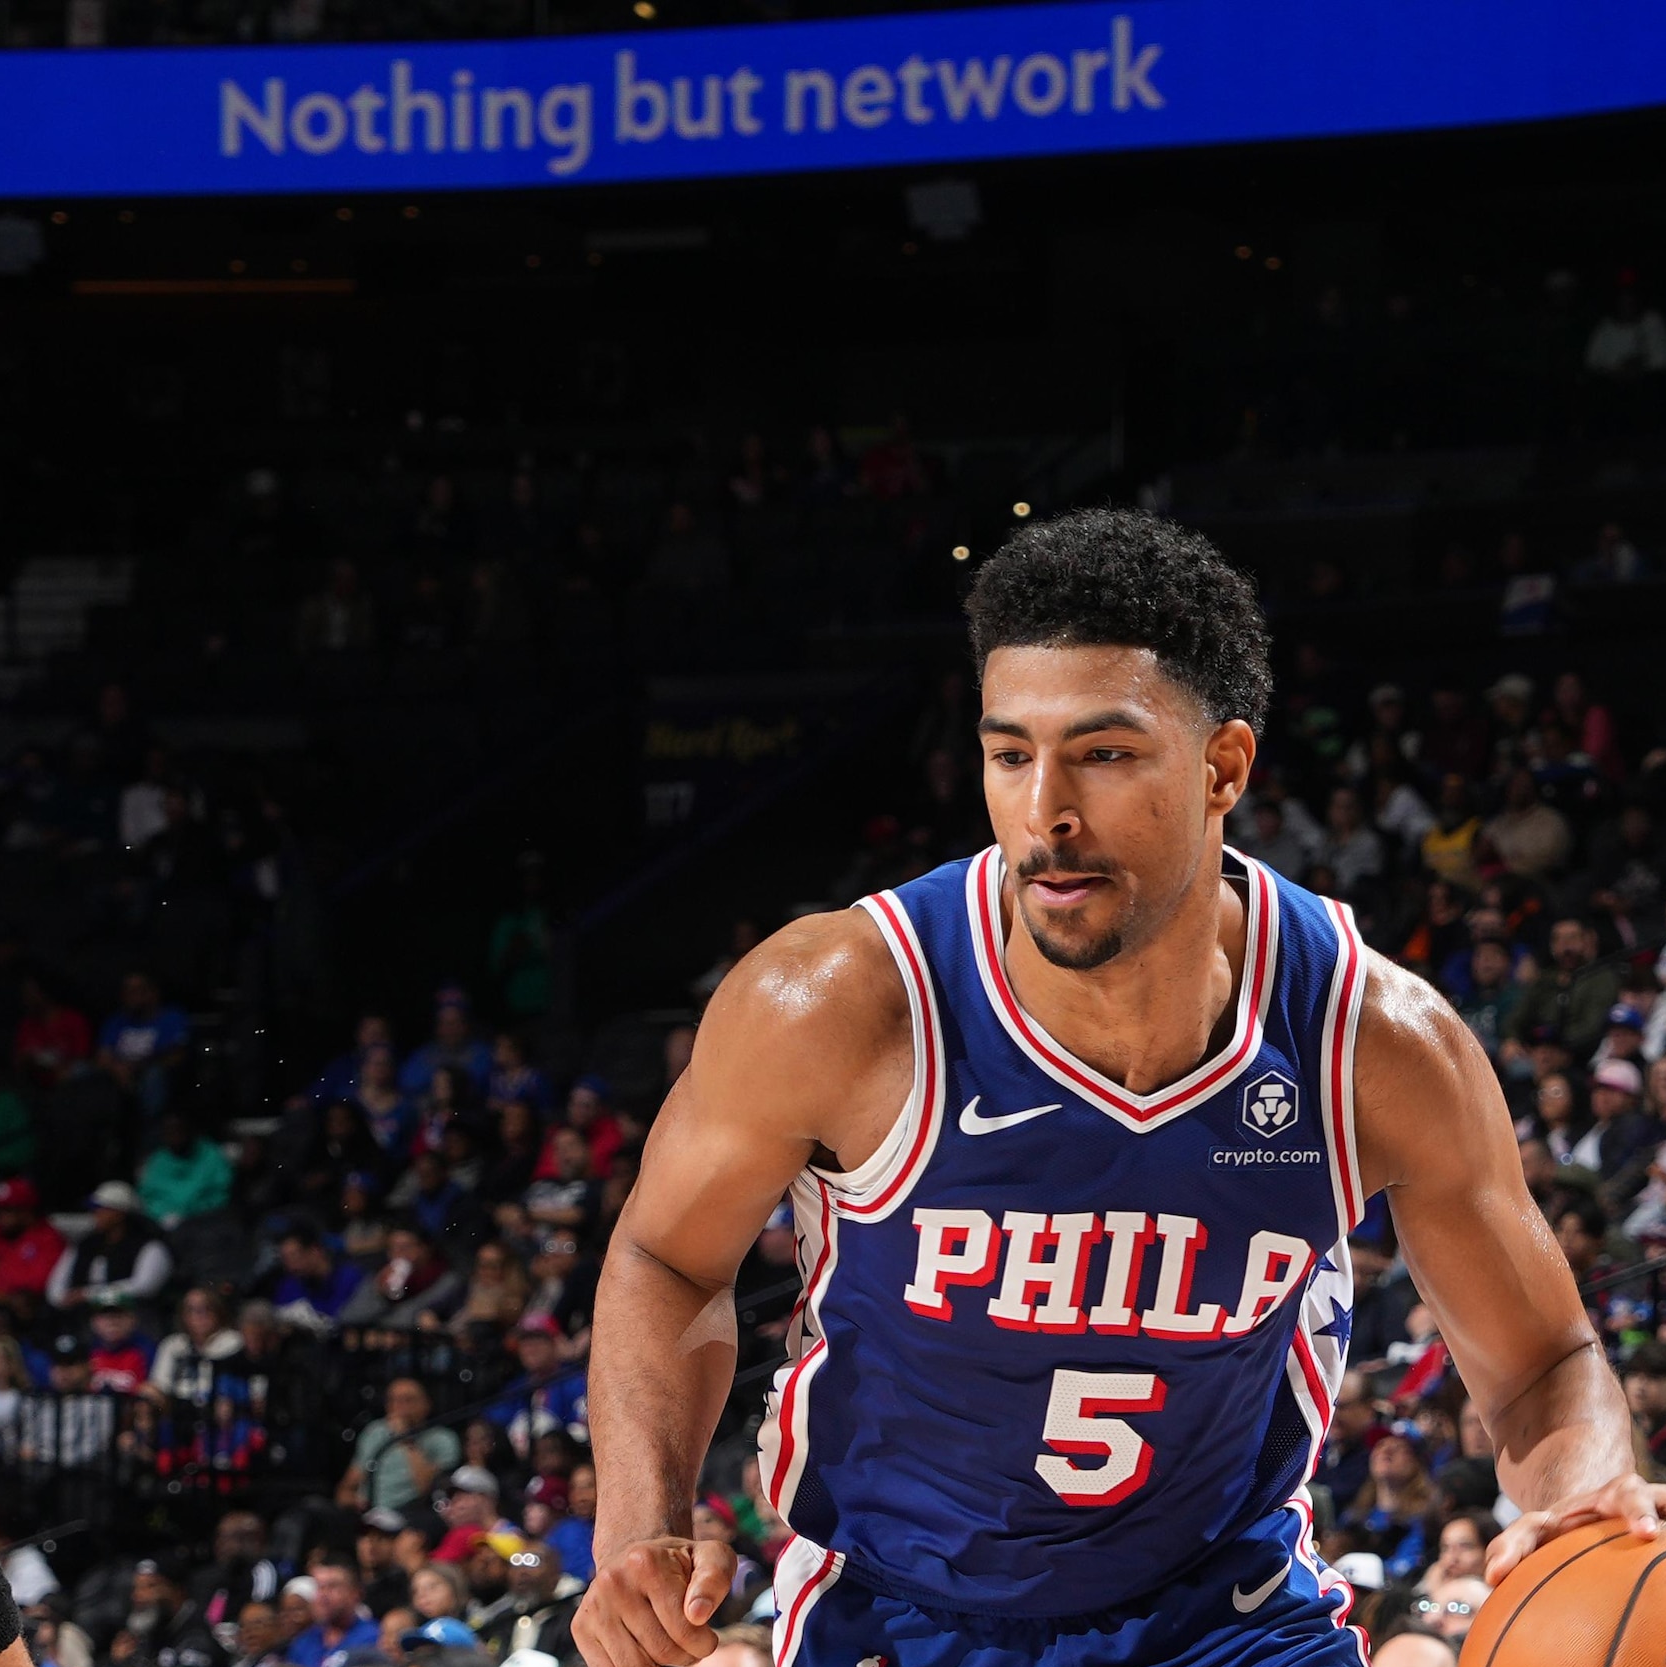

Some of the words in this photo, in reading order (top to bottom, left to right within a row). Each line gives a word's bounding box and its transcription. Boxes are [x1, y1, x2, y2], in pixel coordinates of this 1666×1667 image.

[219, 58, 593, 176] Nothing
[615, 50, 763, 143] but
[784, 15, 1165, 133] network
[1212, 1148, 1321, 1166] crypto.com
[904, 1207, 1316, 1342] PHILA
[1034, 1368, 1168, 1507] 5
